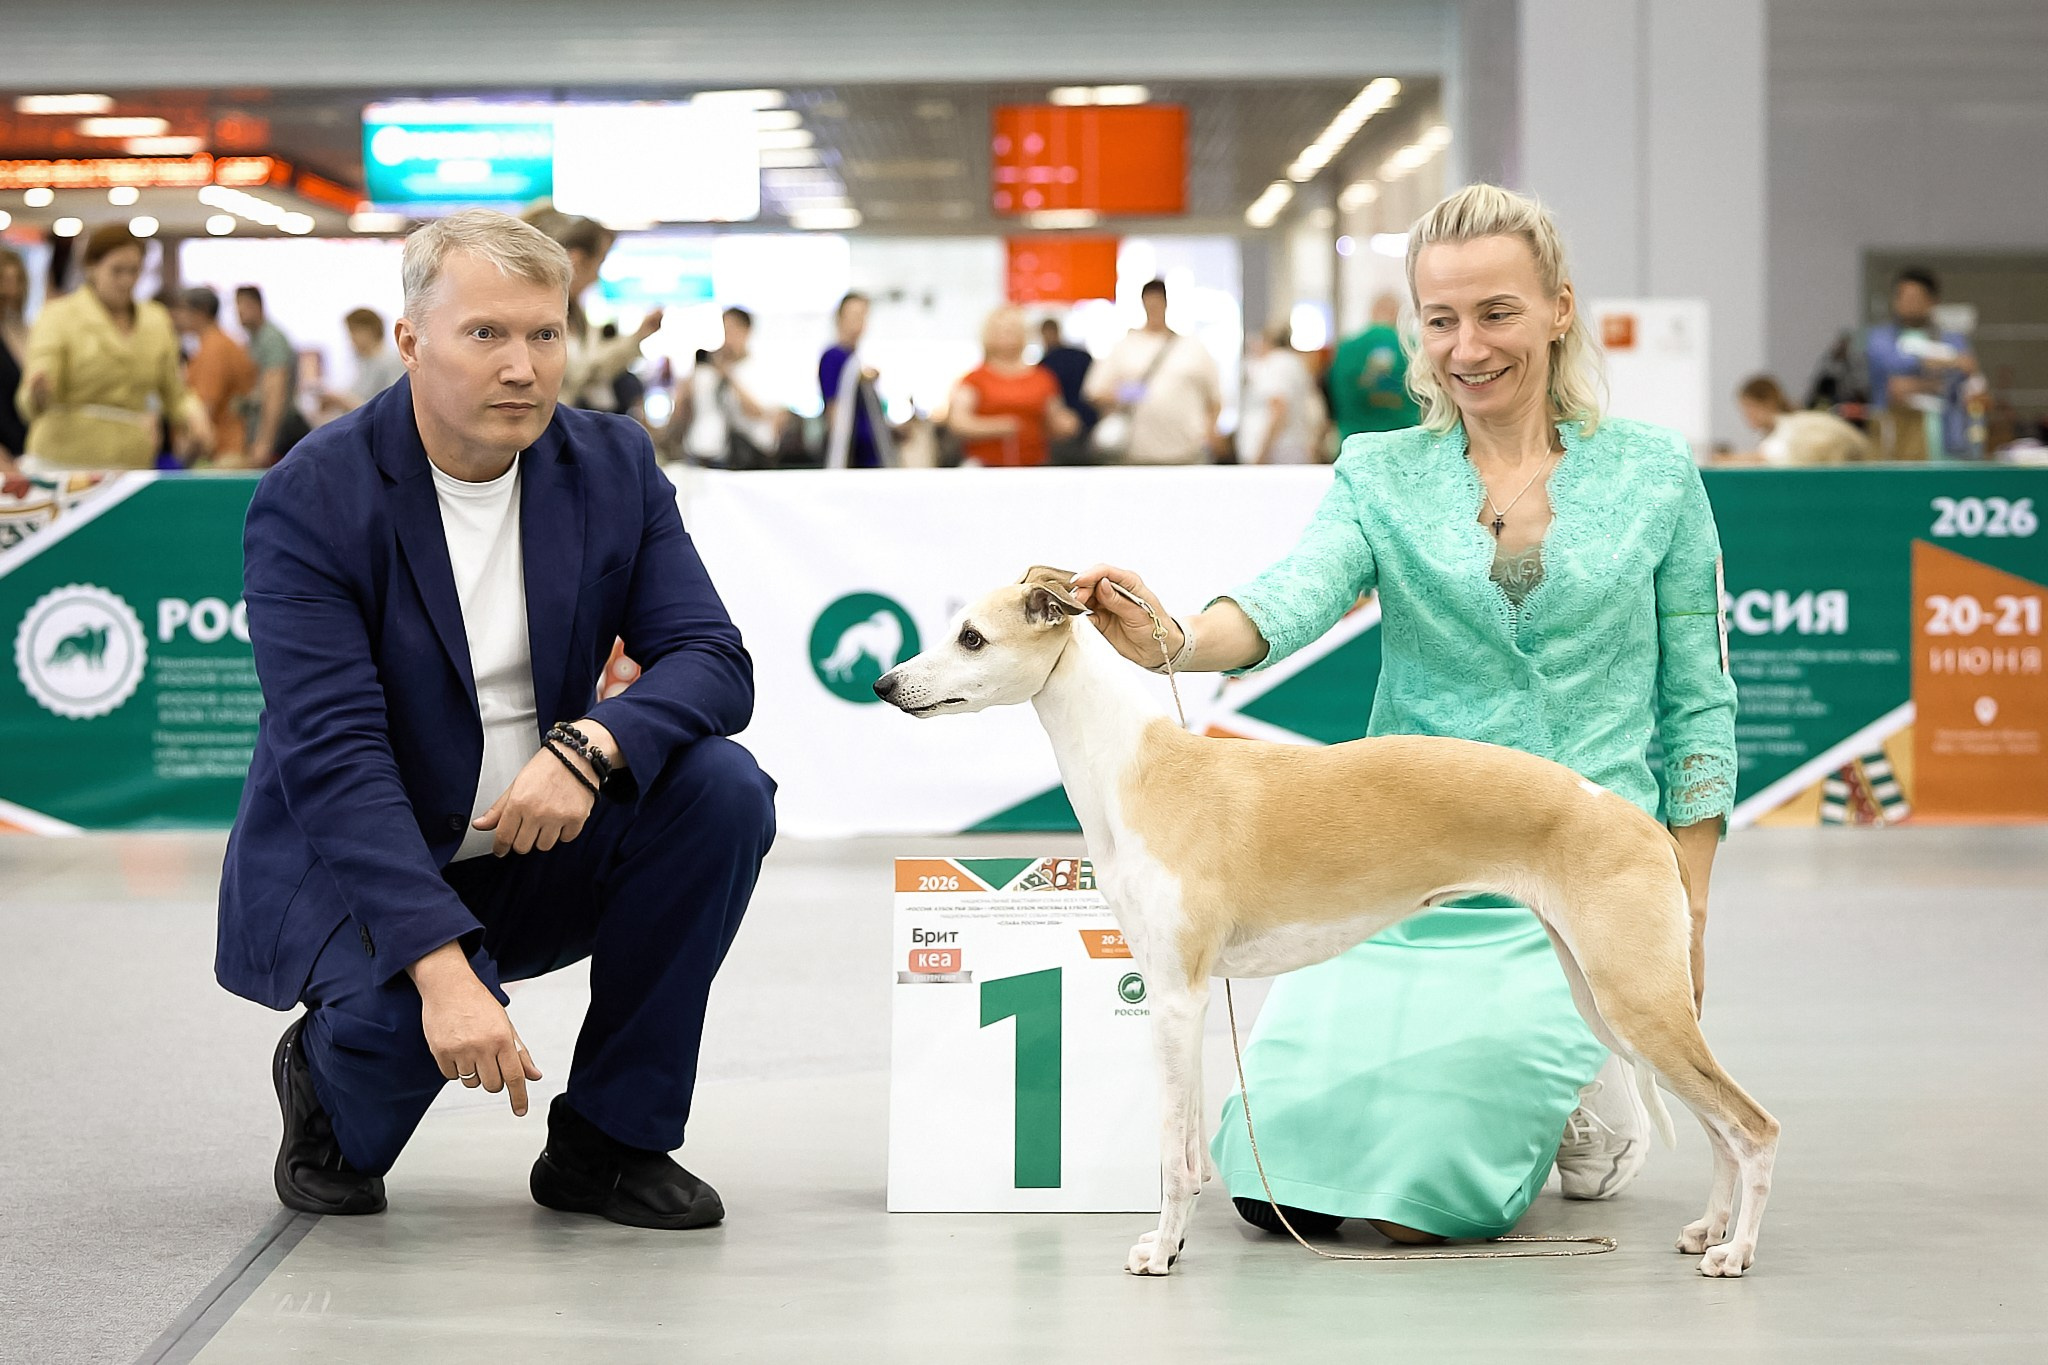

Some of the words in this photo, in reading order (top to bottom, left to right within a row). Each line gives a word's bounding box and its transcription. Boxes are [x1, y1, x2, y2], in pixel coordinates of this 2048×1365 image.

[1930, 496, 2038, 537] 2026
[1925, 595, 2042, 636] 20-21
[1928, 646, 2042, 675] ИЮНЯ
[918, 875, 960, 891] 2026
[912, 928, 959, 947] Брит
[1101, 934, 1127, 945] 20-2
[918, 952, 952, 967] кеа
[1114, 1008, 1151, 1017] РОССИ
[980, 967, 1062, 1189] 1
